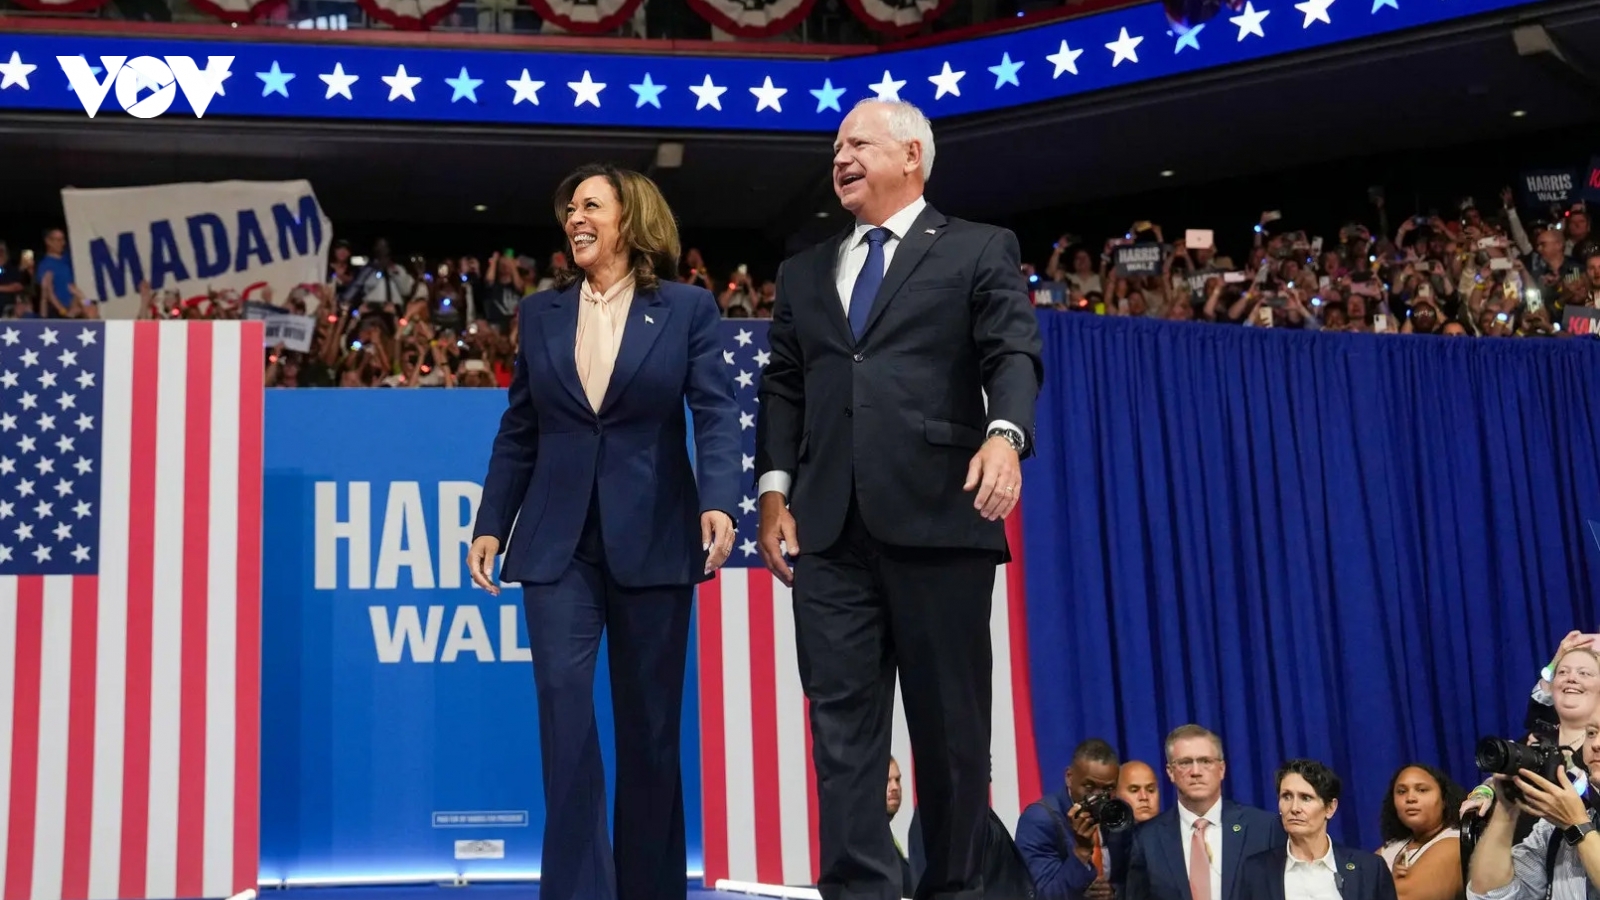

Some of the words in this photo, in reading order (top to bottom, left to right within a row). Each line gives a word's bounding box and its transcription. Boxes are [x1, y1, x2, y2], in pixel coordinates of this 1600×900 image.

[1526, 174, 1572, 192] HARRIS
[1537, 191, 1568, 201] WALZ
[89, 195, 323, 303] MADAM
[1119, 247, 1160, 262] HARRIS
[1126, 262, 1154, 271] WALZ
[314, 481, 521, 589] HAR
